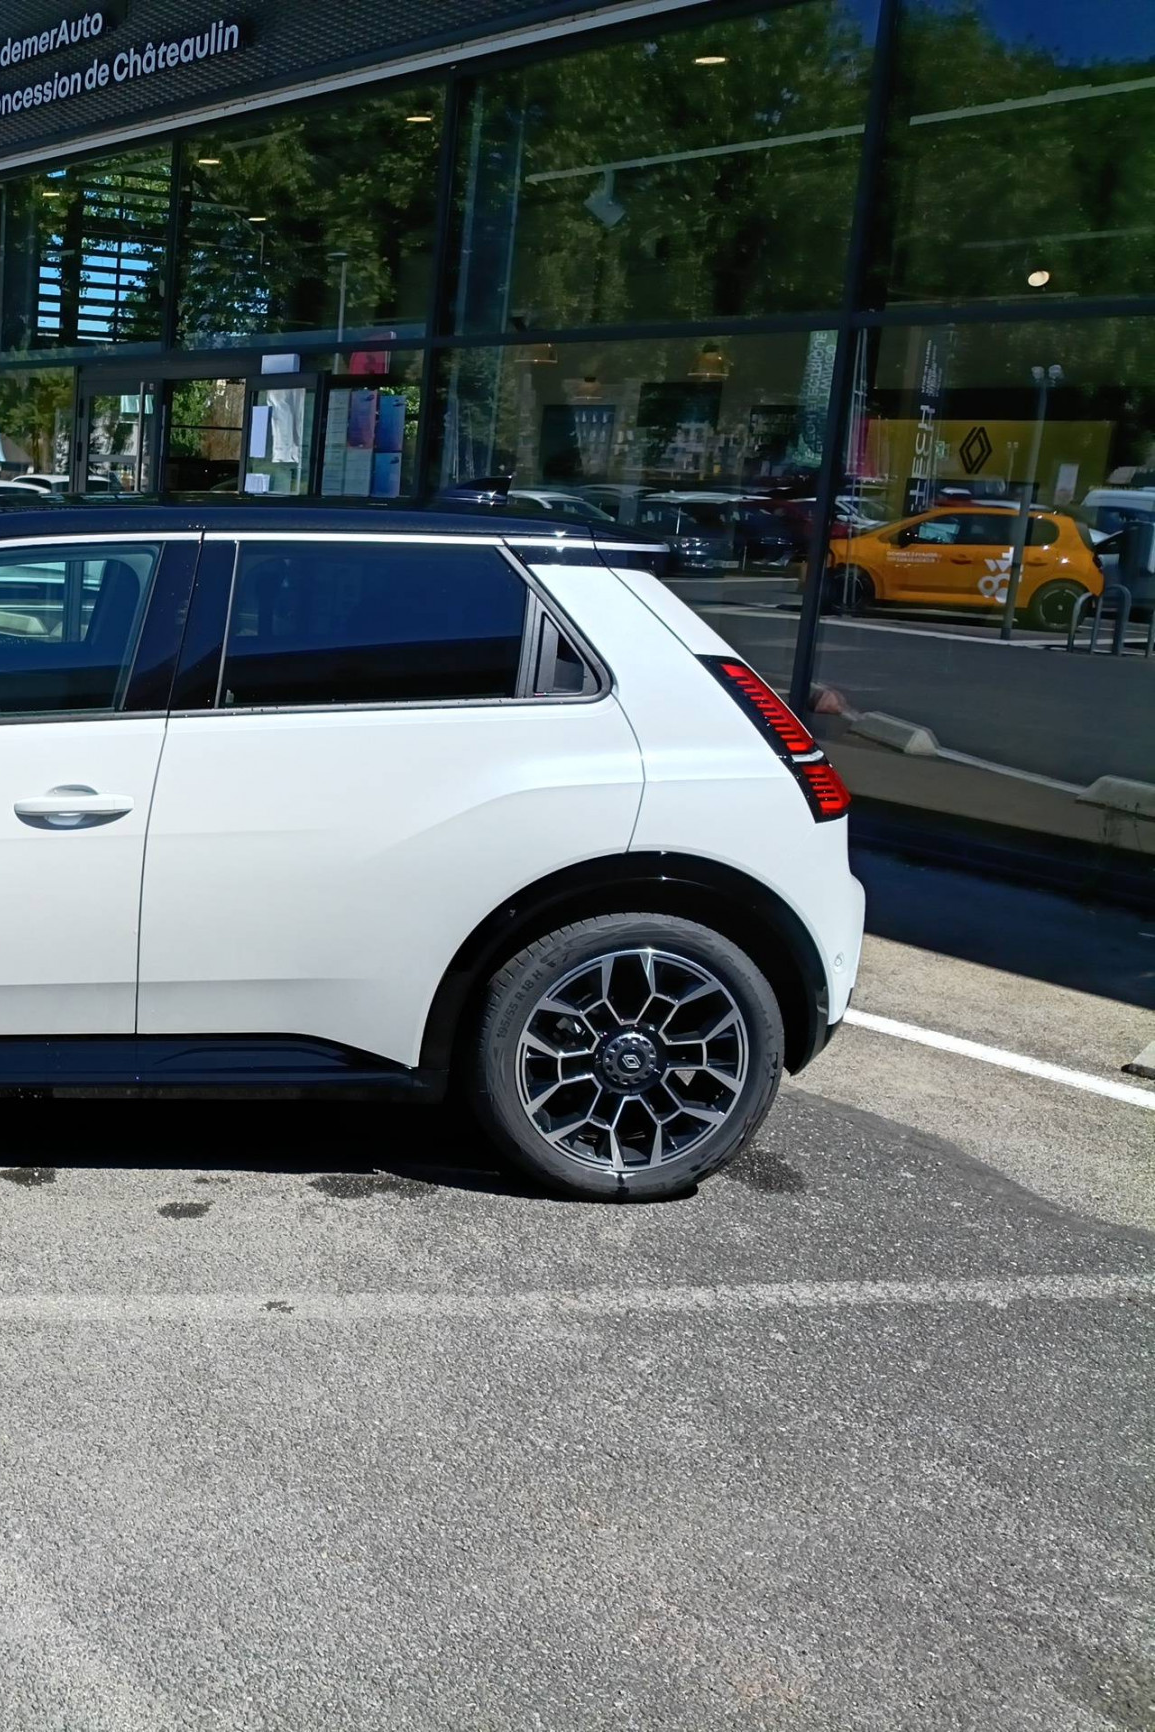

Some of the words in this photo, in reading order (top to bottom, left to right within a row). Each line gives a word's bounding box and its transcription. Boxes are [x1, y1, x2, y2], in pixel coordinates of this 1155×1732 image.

[84, 59, 110, 91] de
[112, 19, 240, 82] Châteaulin
[496, 1002, 519, 1038] 195/55
[514, 991, 526, 1001] R
[521, 980, 535, 992] 18
[532, 969, 543, 980] H
